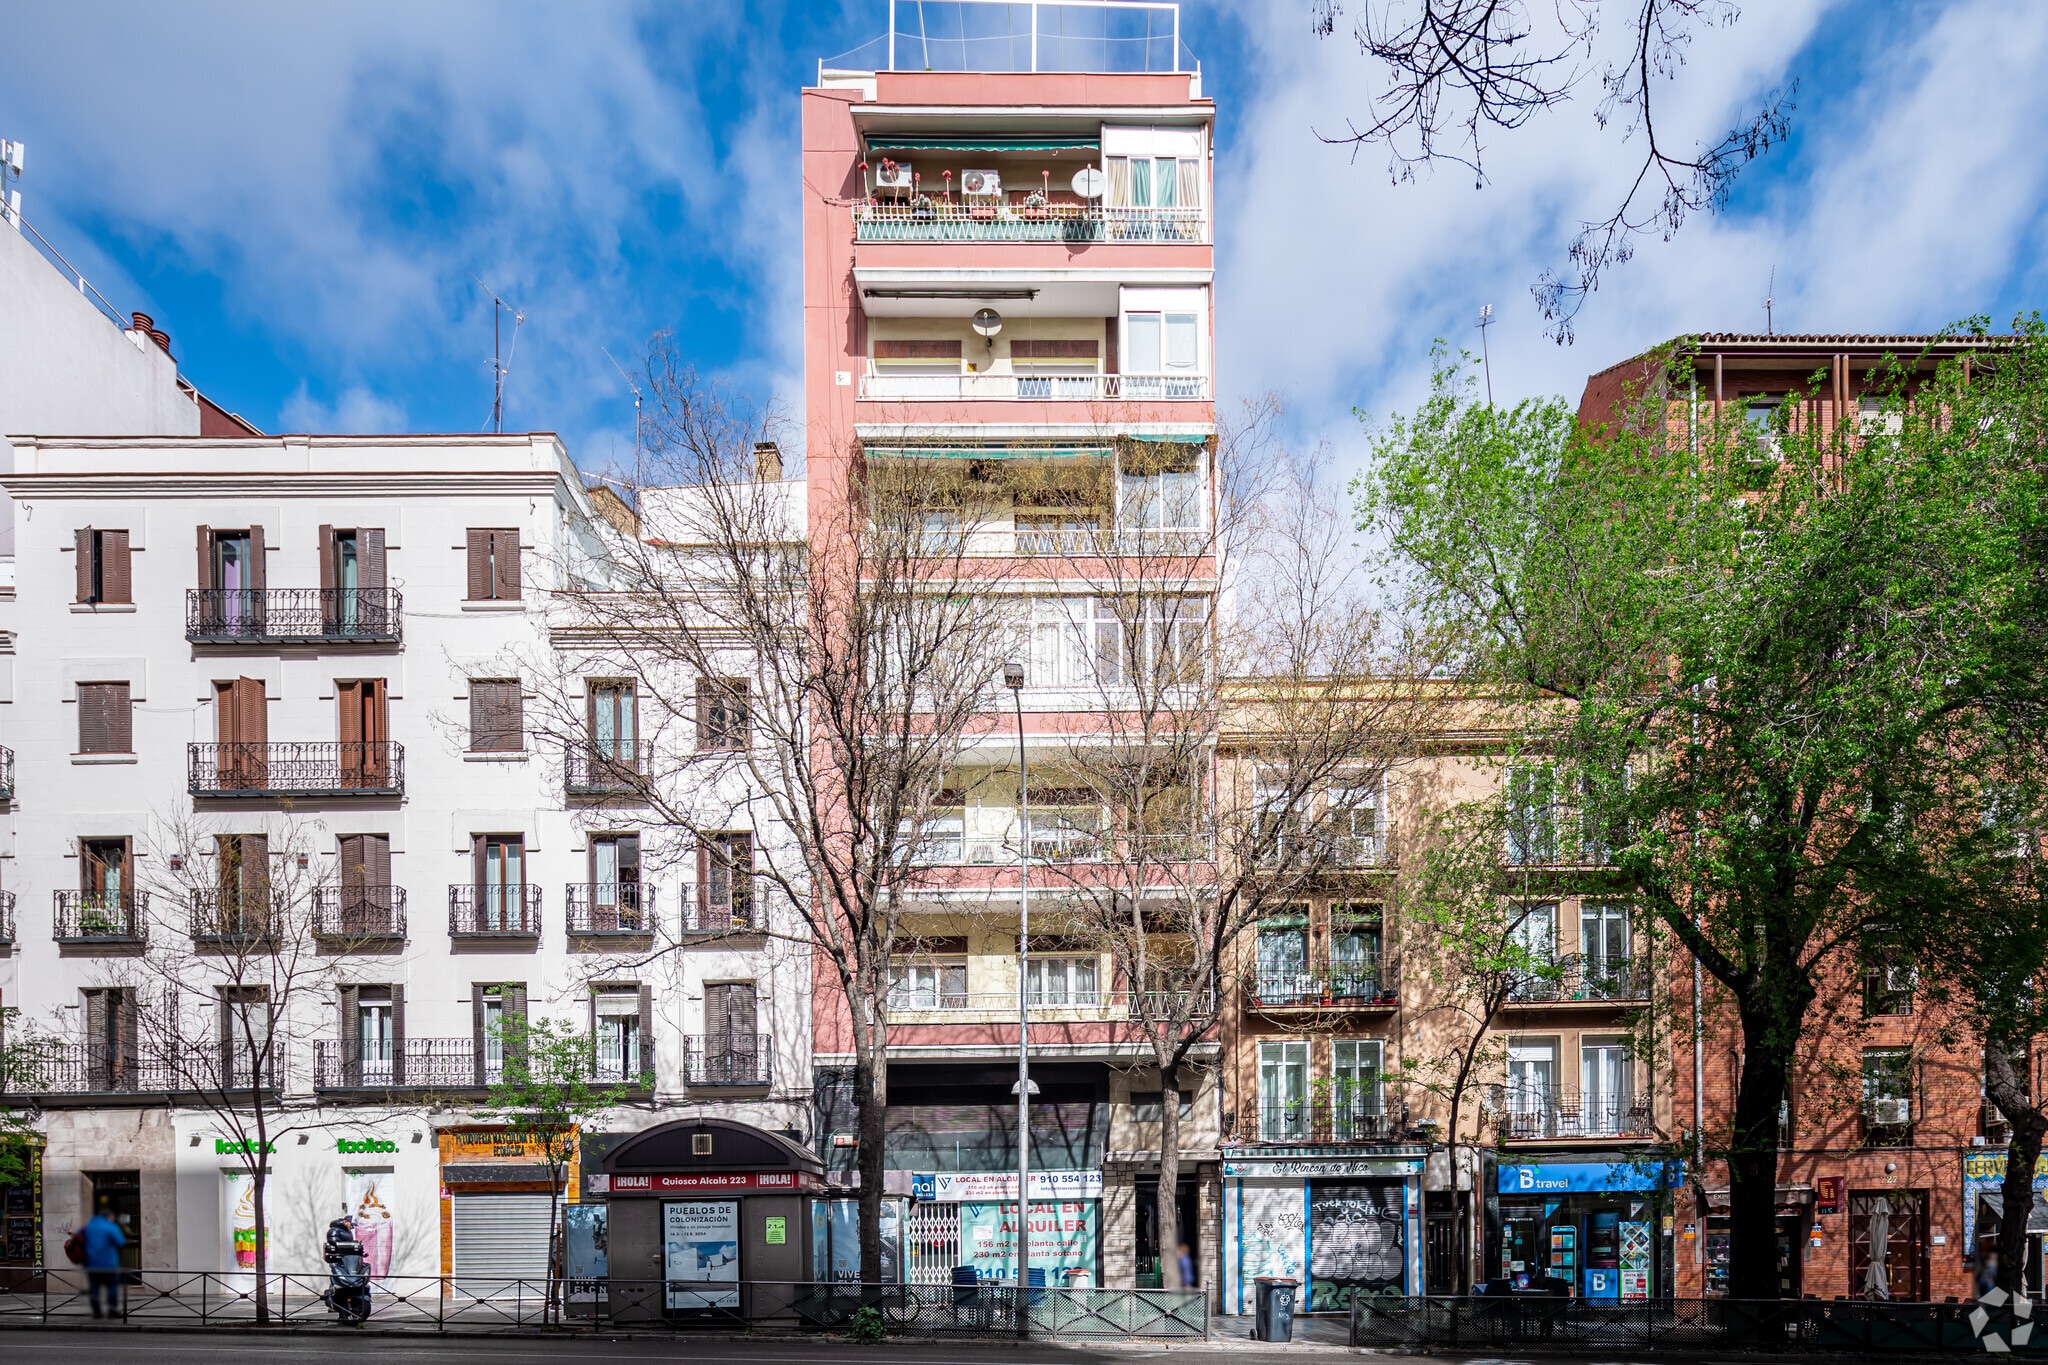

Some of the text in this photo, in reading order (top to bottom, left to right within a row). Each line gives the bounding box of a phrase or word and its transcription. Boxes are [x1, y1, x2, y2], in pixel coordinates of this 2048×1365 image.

[1330, 1163, 1342, 1172] de
[1347, 1160, 1370, 1173] Nico
[617, 1176, 649, 1187] ¡HOLA!
[662, 1176, 747, 1186] Quiosco Alcalá 223
[759, 1174, 791, 1185] ¡HOLA!
[1040, 1175, 1058, 1183] 910
[1520, 1169, 1569, 1189] B travel
[1062, 1202, 1085, 1213] EN
[1593, 1273, 1606, 1291] B
